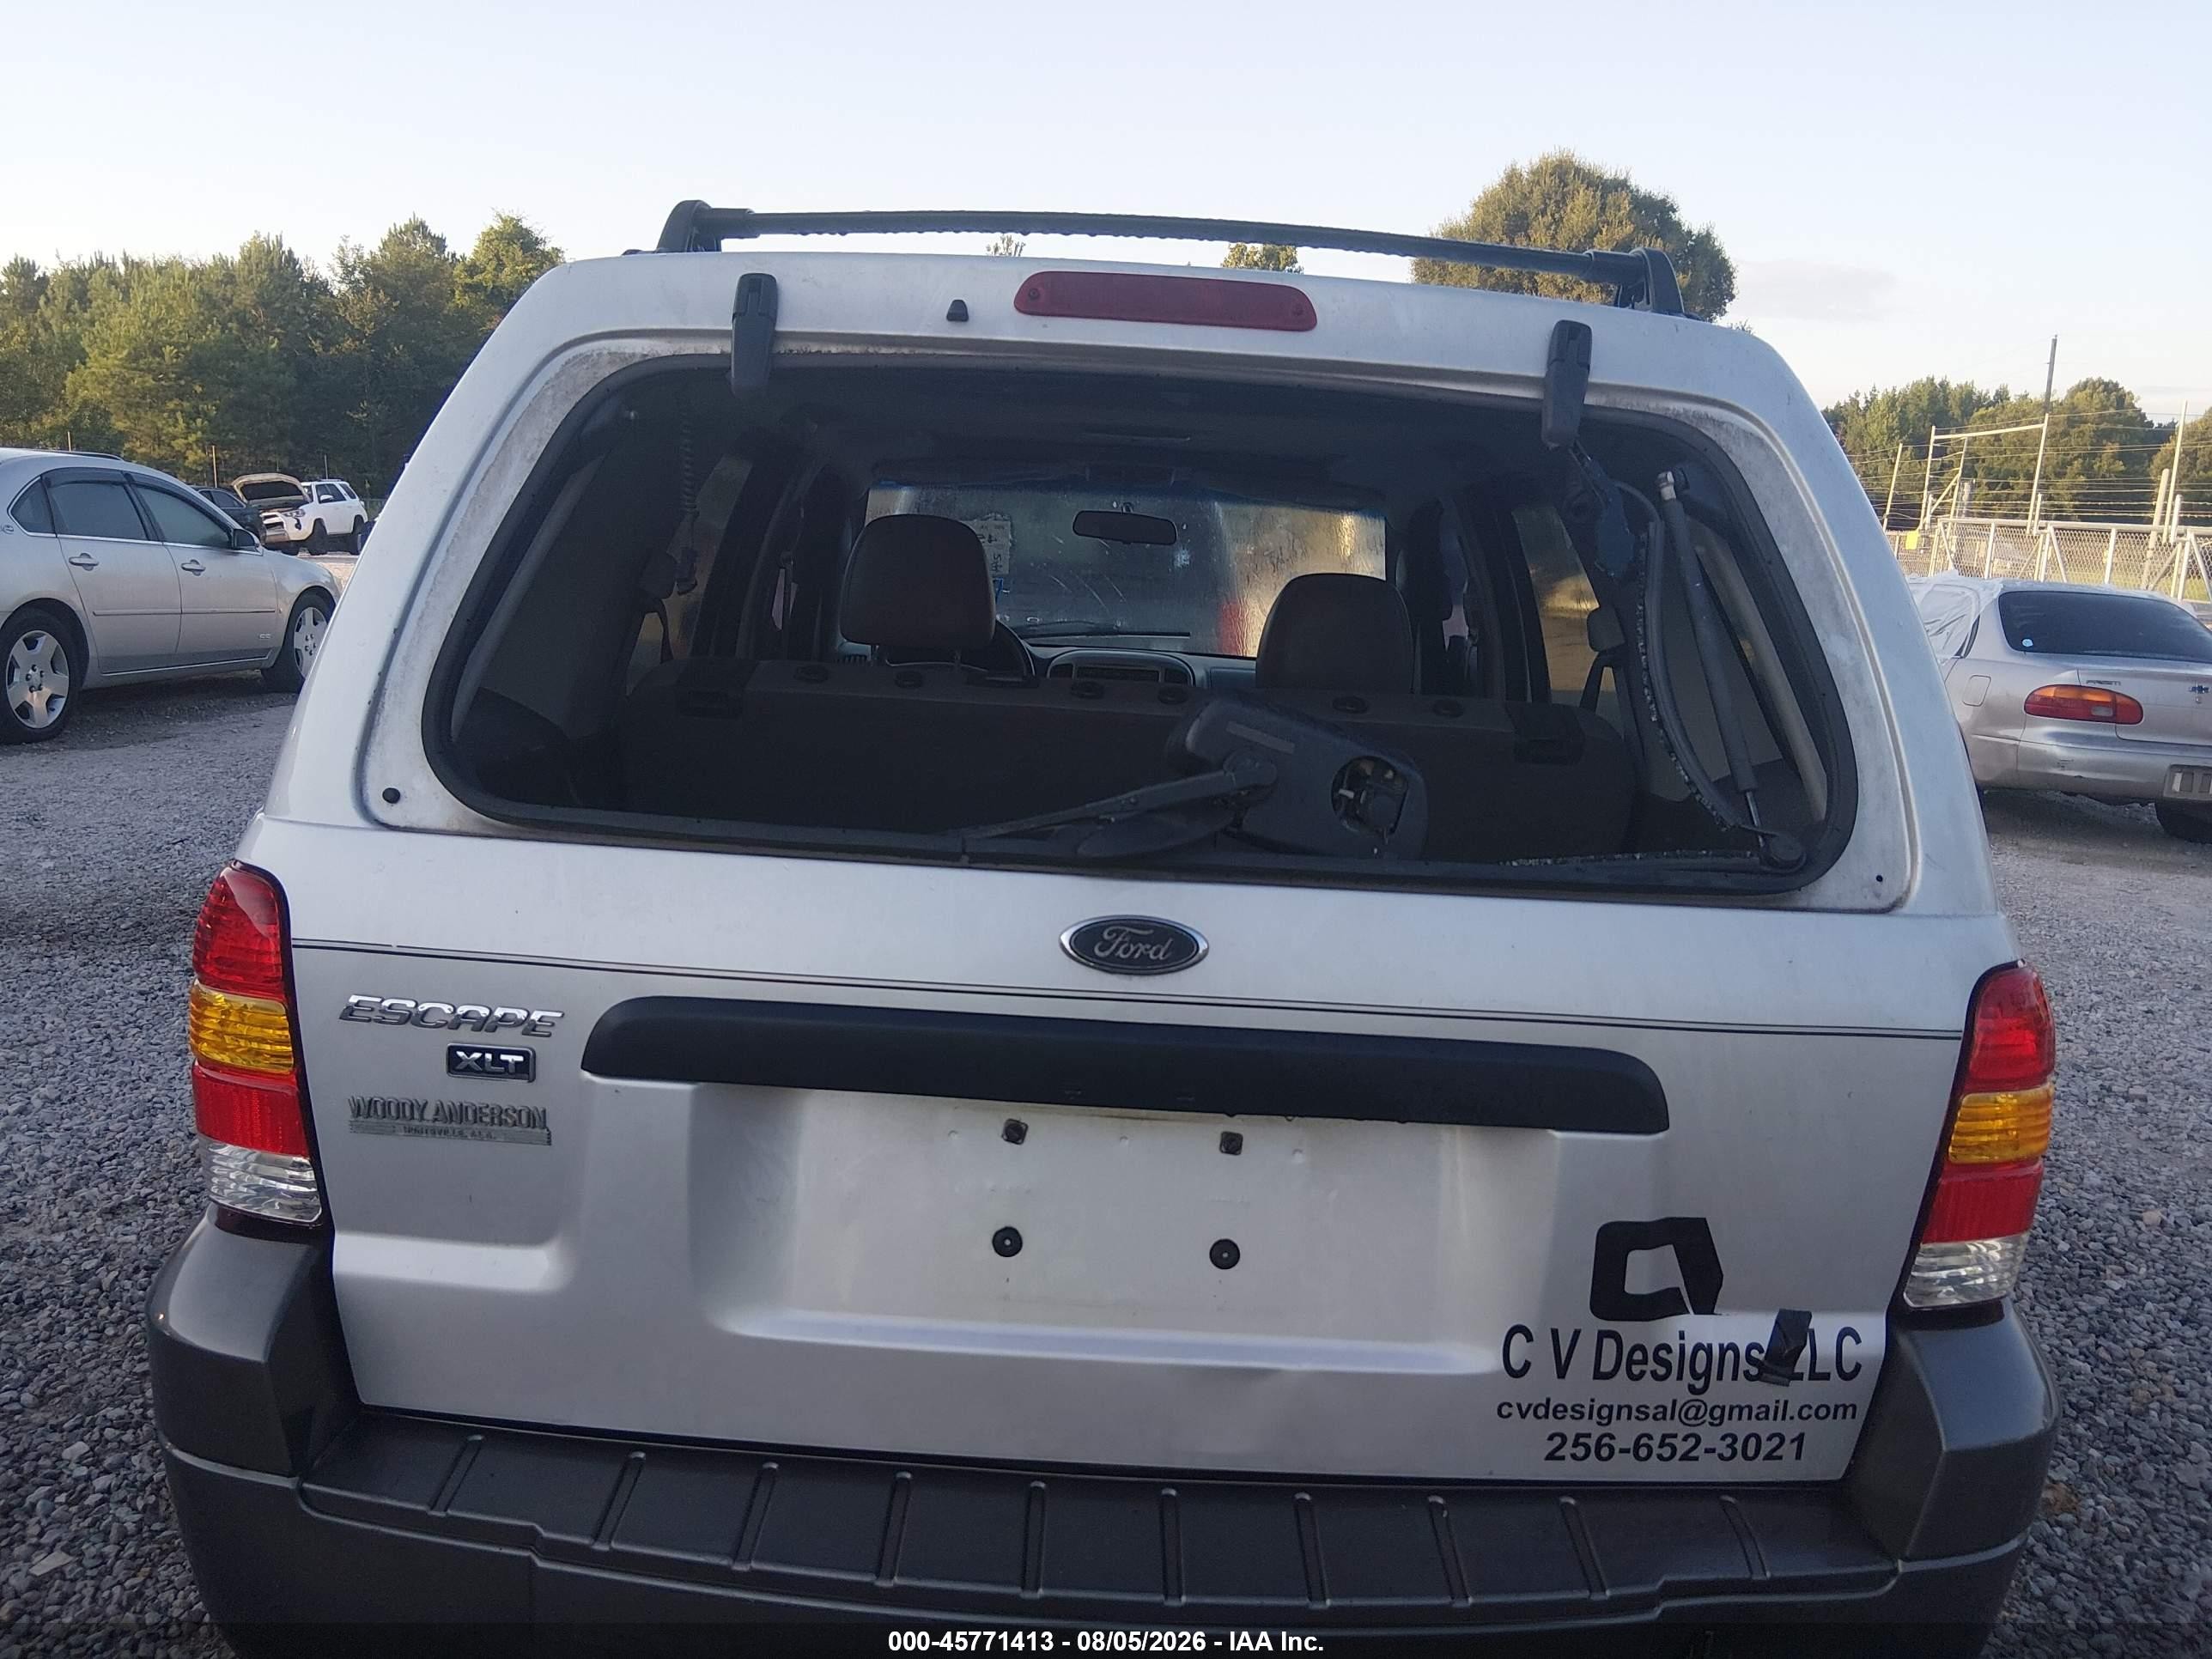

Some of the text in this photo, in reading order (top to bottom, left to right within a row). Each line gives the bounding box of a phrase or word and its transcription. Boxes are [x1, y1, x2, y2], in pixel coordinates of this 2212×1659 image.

[1093, 925, 1174, 960] Ford
[339, 994, 565, 1037] ESCAPE
[454, 1050, 525, 1073] XLT
[347, 1096, 548, 1129] WOODY ANDERSON
[1502, 1323, 1863, 1395] C V Designs LC
[1497, 1397, 1857, 1427] cvdesignsal@gmail.com
[1545, 1431, 1806, 1462] 256-652-3021
